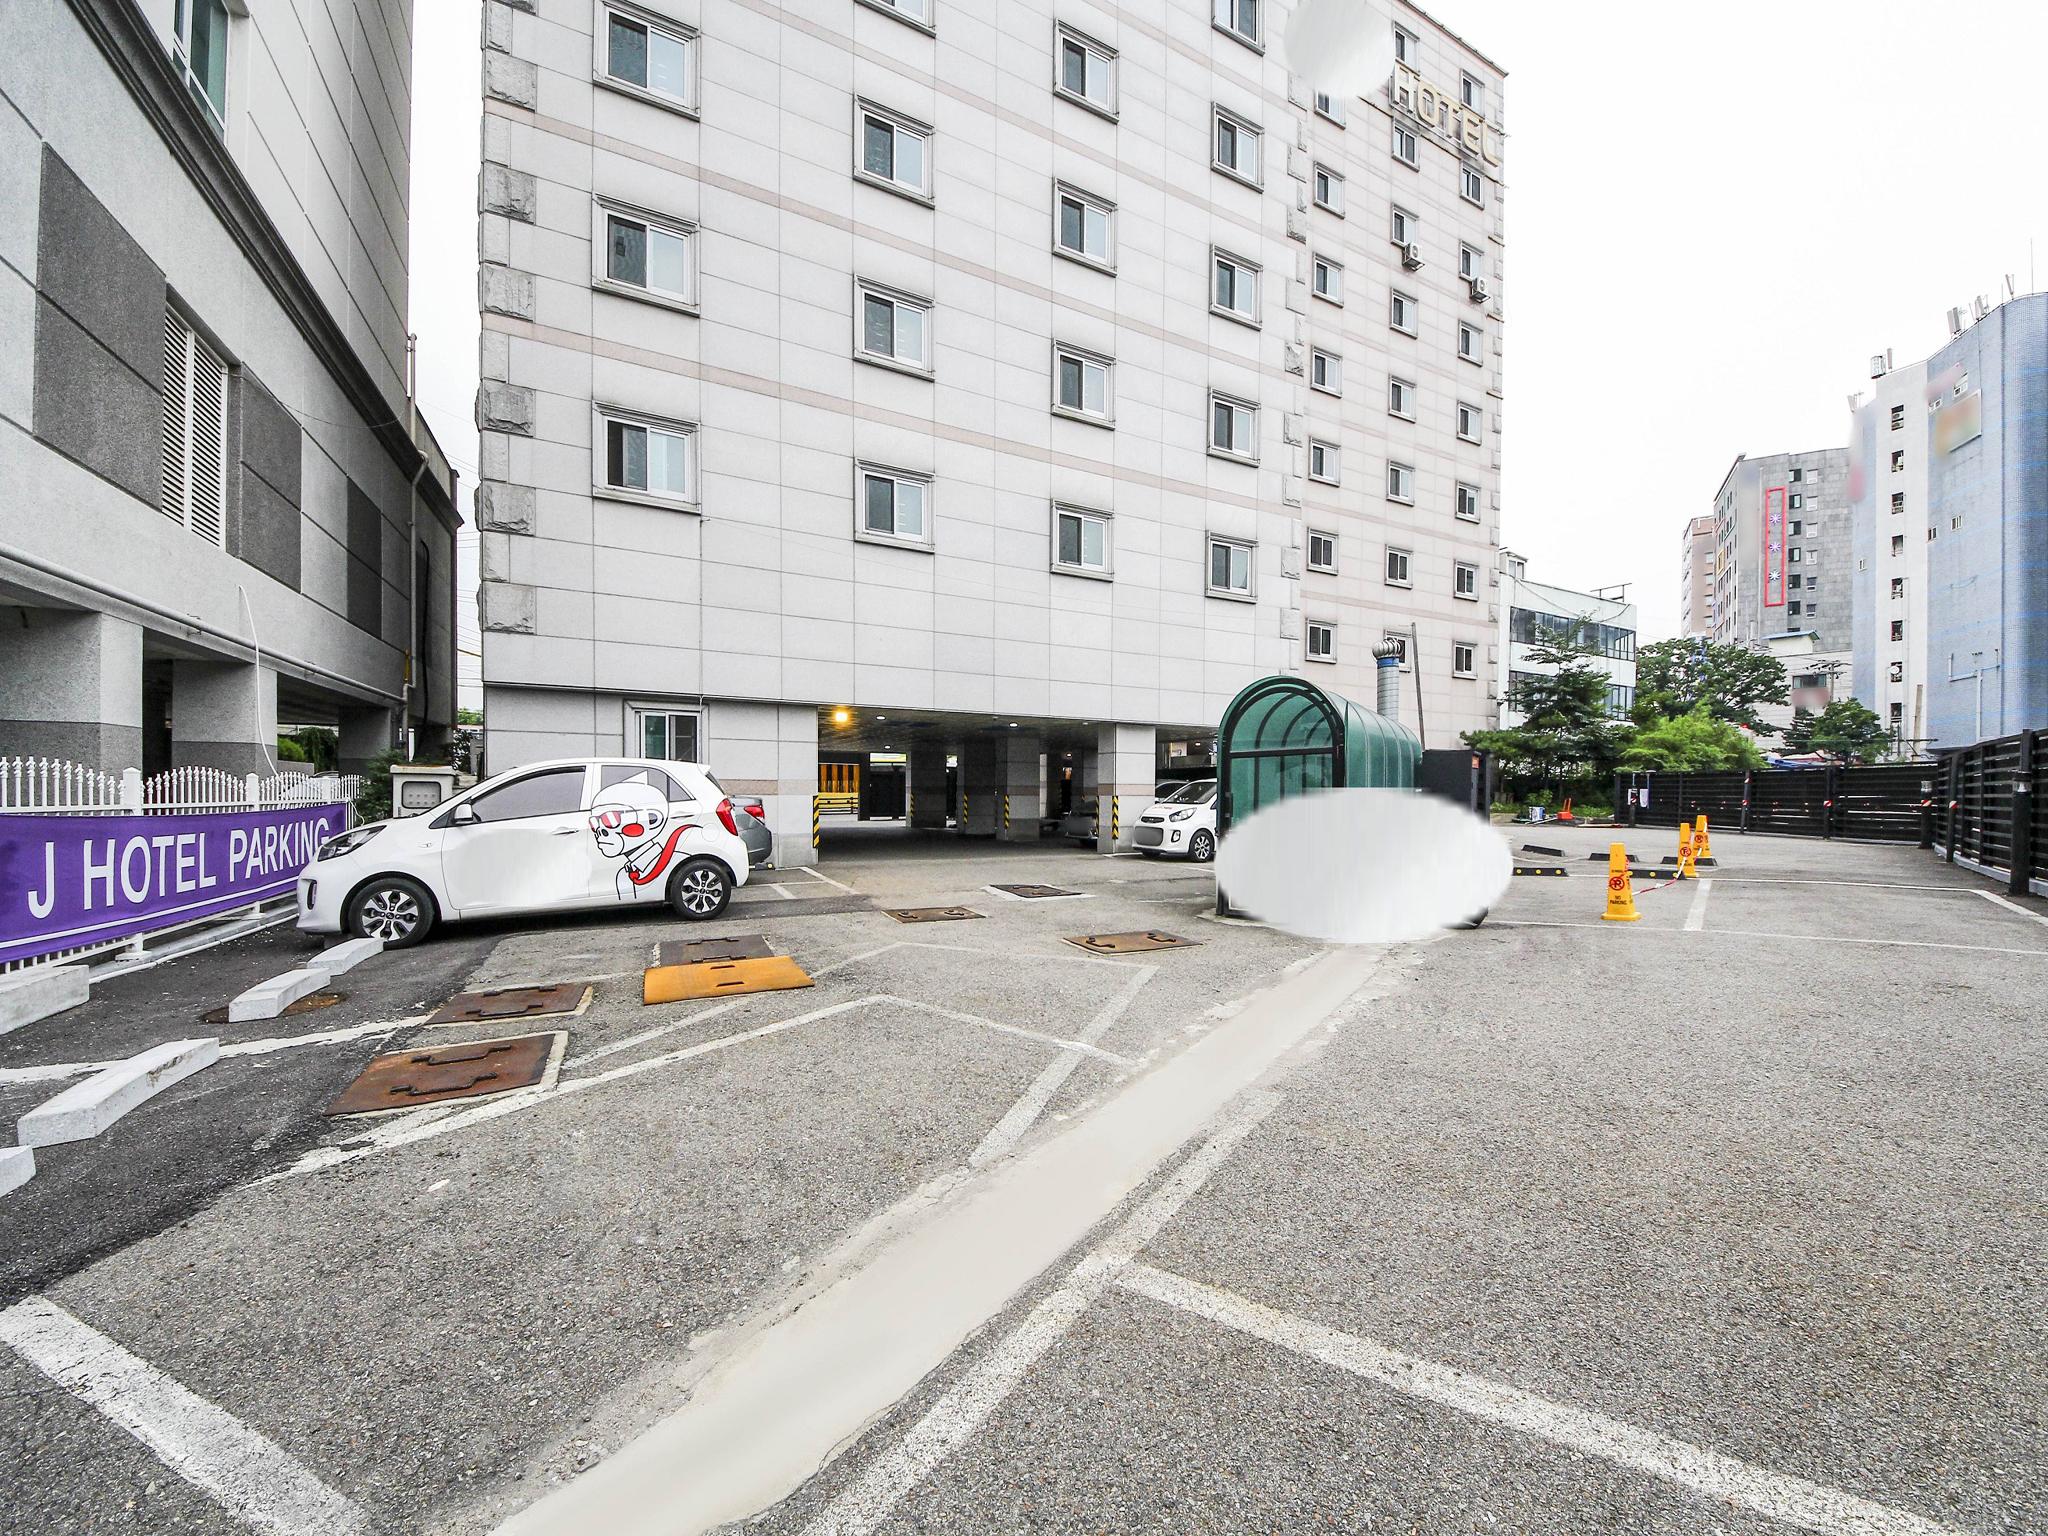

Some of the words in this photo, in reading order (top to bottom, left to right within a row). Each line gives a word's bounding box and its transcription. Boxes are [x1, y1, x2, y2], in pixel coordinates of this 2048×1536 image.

[1392, 62, 1500, 168] HOTEL
[27, 841, 55, 919] J
[83, 832, 217, 911] HOTEL
[229, 817, 330, 883] PARKING
